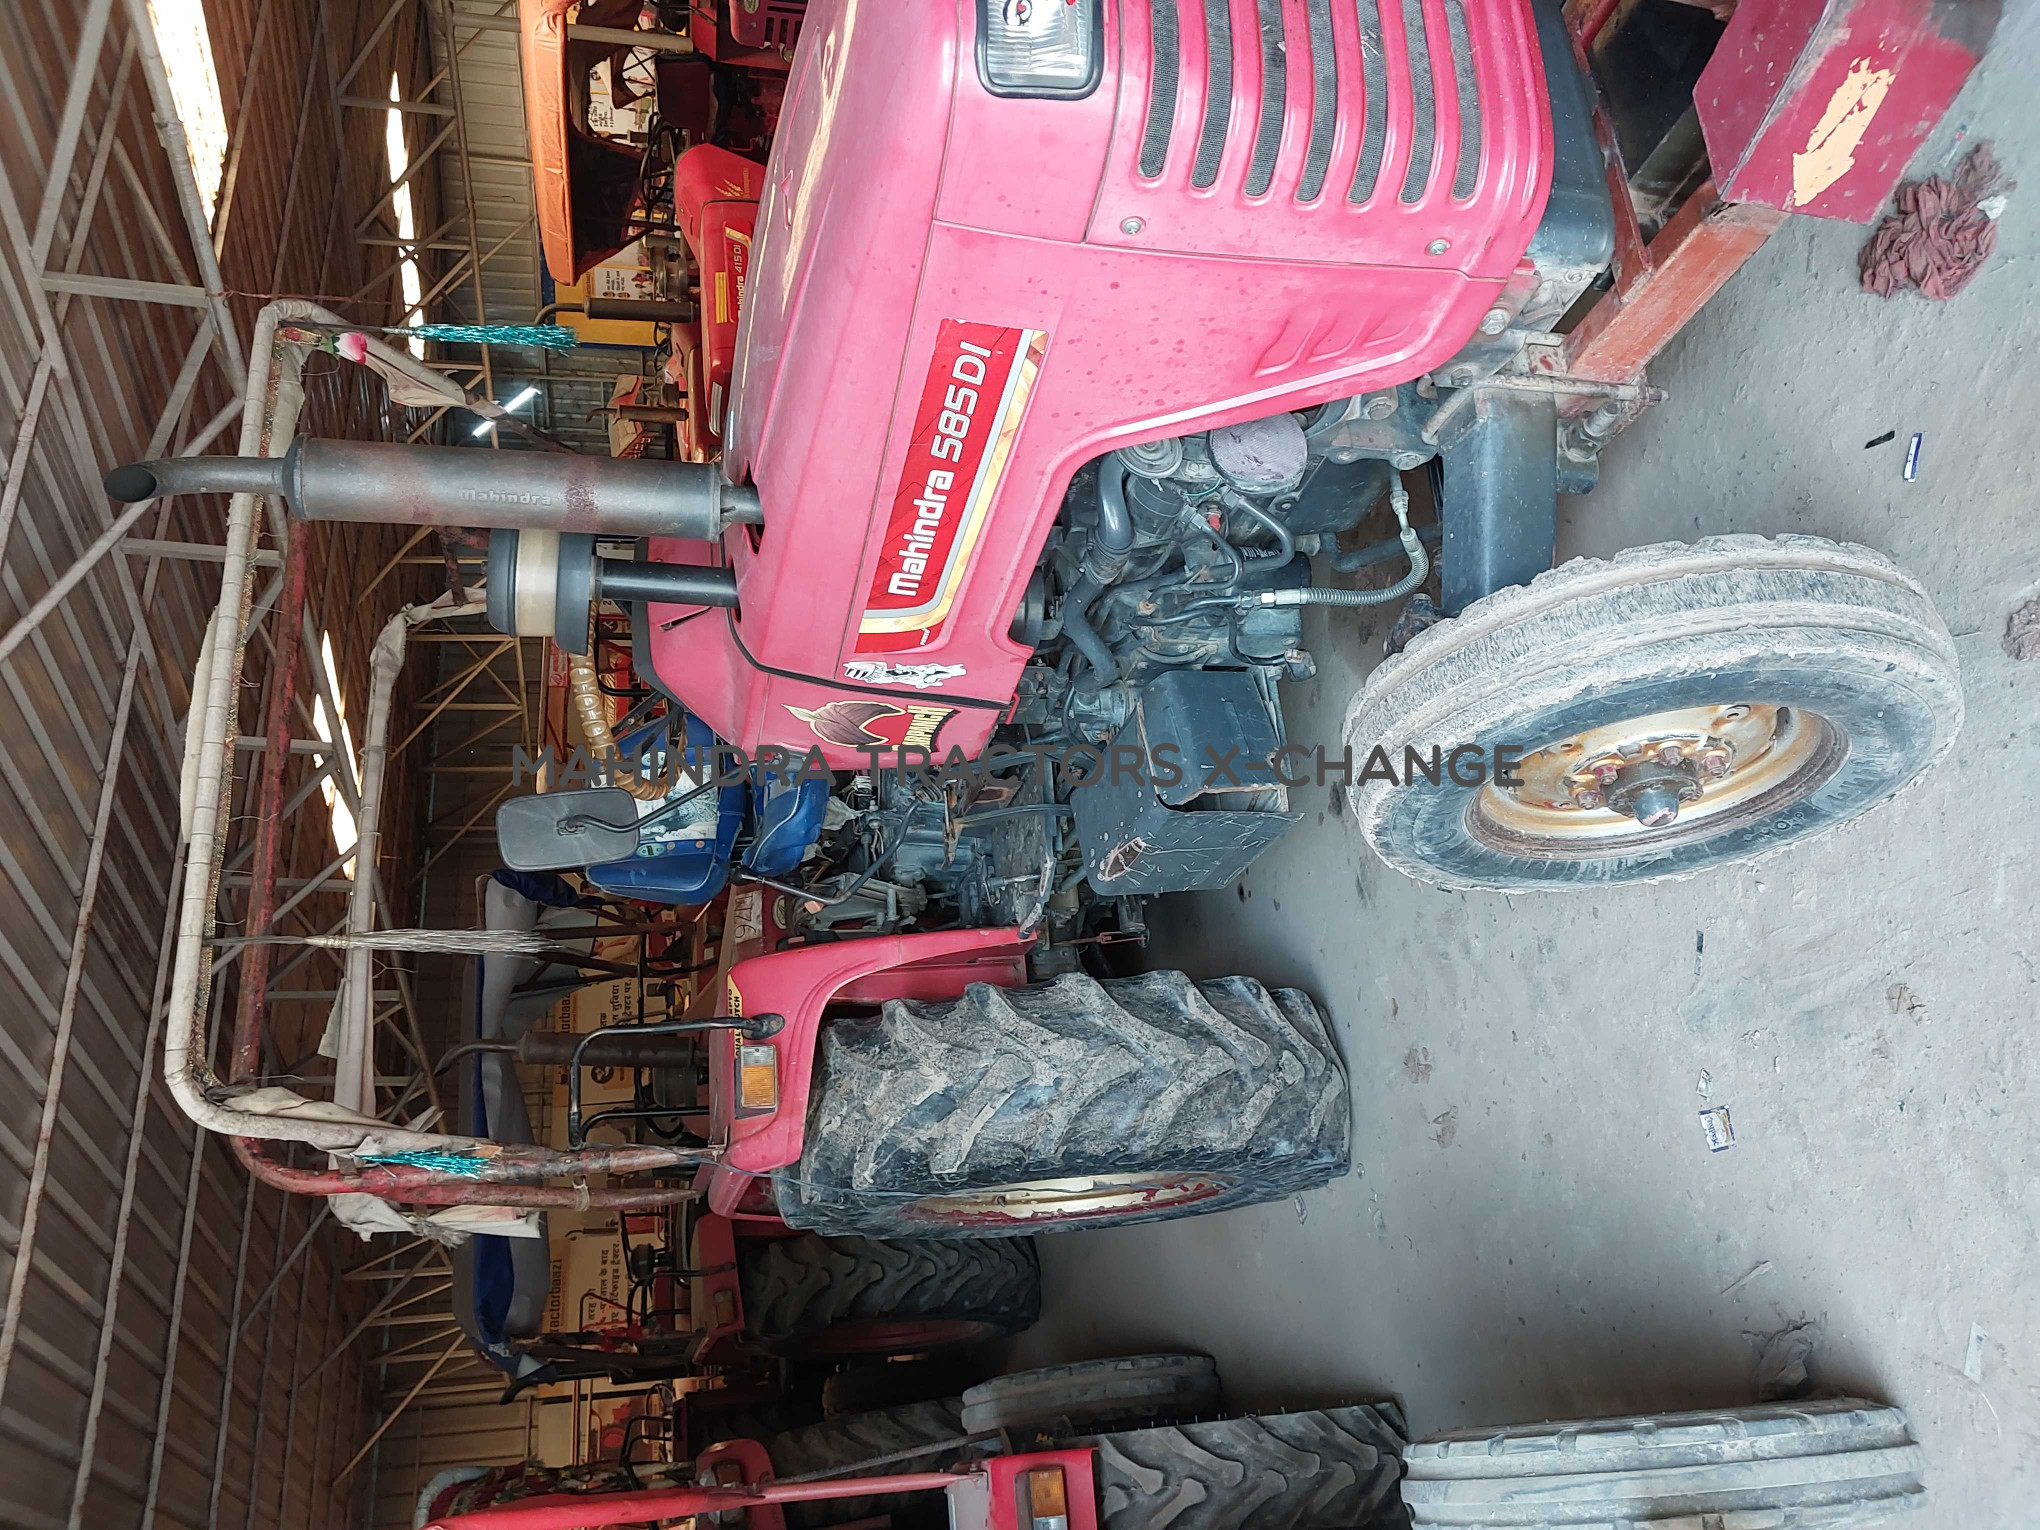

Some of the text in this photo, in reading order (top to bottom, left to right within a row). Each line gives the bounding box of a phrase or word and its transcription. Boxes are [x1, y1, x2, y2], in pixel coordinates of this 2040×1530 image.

[733, 244, 742, 255] DI
[734, 254, 743, 274] 415
[887, 340, 992, 597] Mahindra 585 DI
[458, 488, 552, 506] Mahindra
[549, 1260, 562, 1333] ractorbaazi
